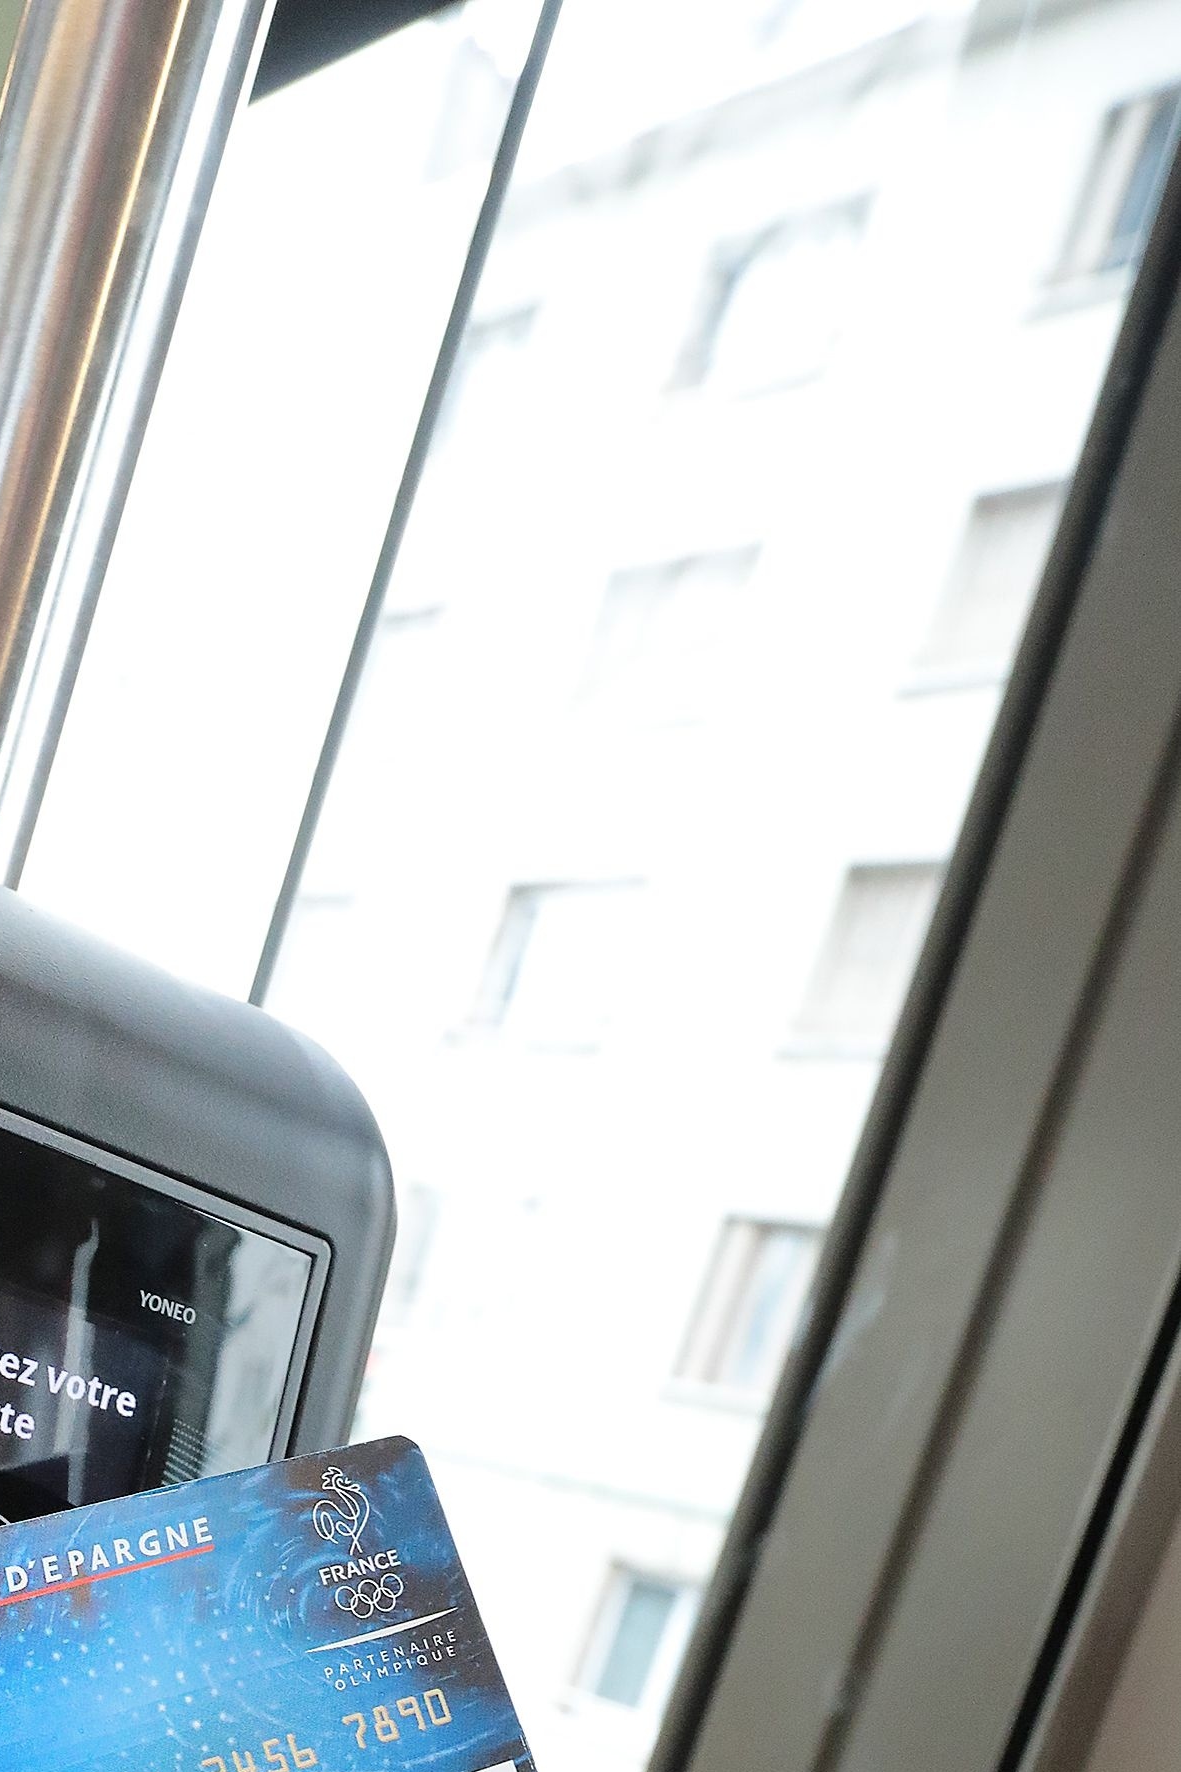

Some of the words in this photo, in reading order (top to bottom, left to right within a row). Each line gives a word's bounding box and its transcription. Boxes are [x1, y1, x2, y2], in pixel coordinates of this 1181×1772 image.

[138, 1289, 197, 1325] YONEO
[45, 1364, 138, 1418] votre
[5, 1516, 214, 1593] D'EPARGNE
[319, 1549, 401, 1586] FRANCE
[324, 1630, 457, 1679] PARTENAIRE
[334, 1645, 457, 1691] OLYMPIQUE
[342, 1688, 453, 1749] 7890
